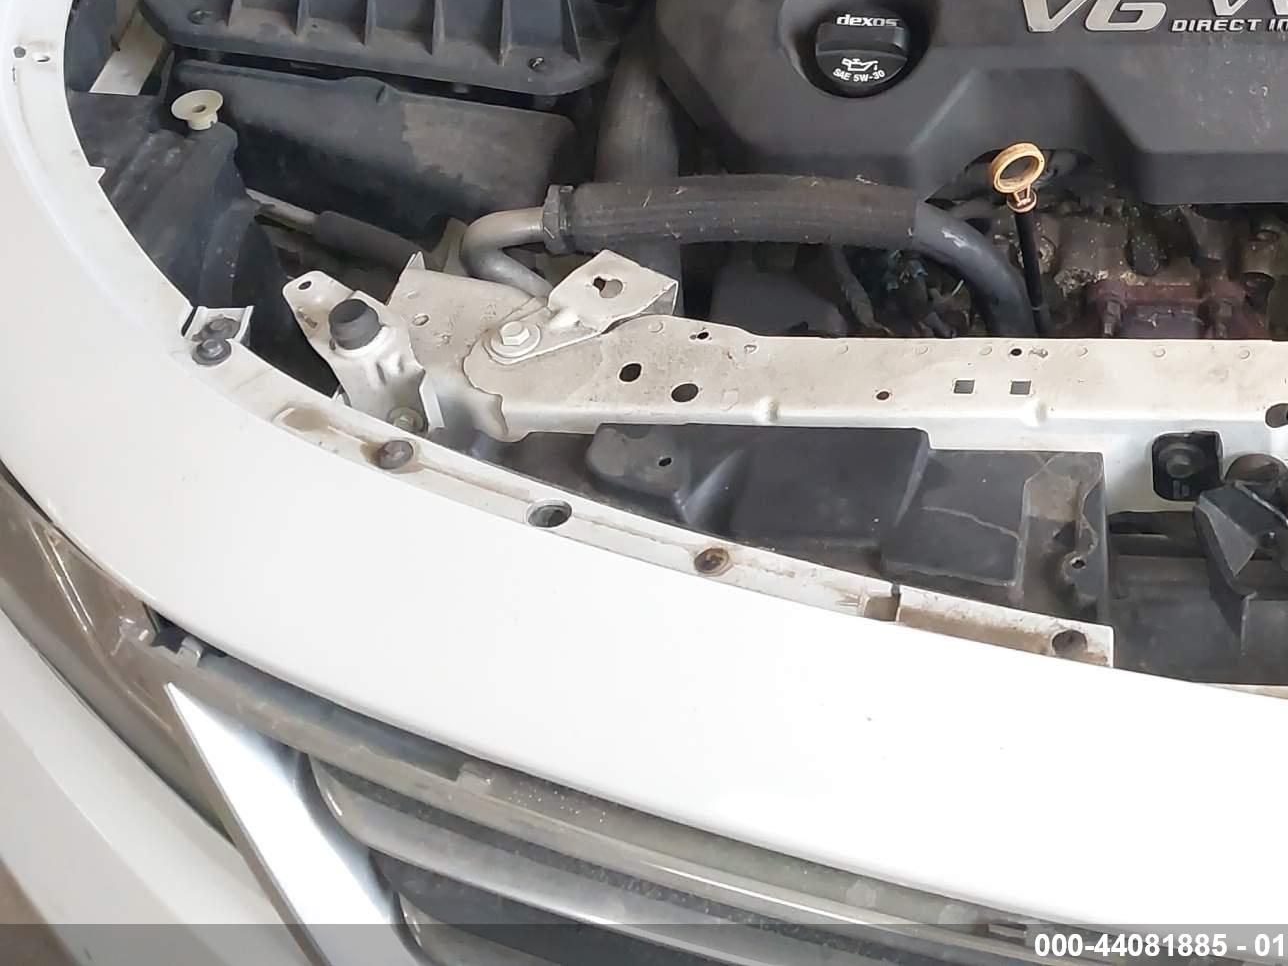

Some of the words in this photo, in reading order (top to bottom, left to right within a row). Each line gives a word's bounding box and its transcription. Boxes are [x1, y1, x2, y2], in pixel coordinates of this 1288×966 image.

[836, 14, 899, 27] dexos
[1171, 18, 1261, 33] DIRECT
[833, 68, 851, 81] SAE
[853, 69, 885, 82] 5W-30
